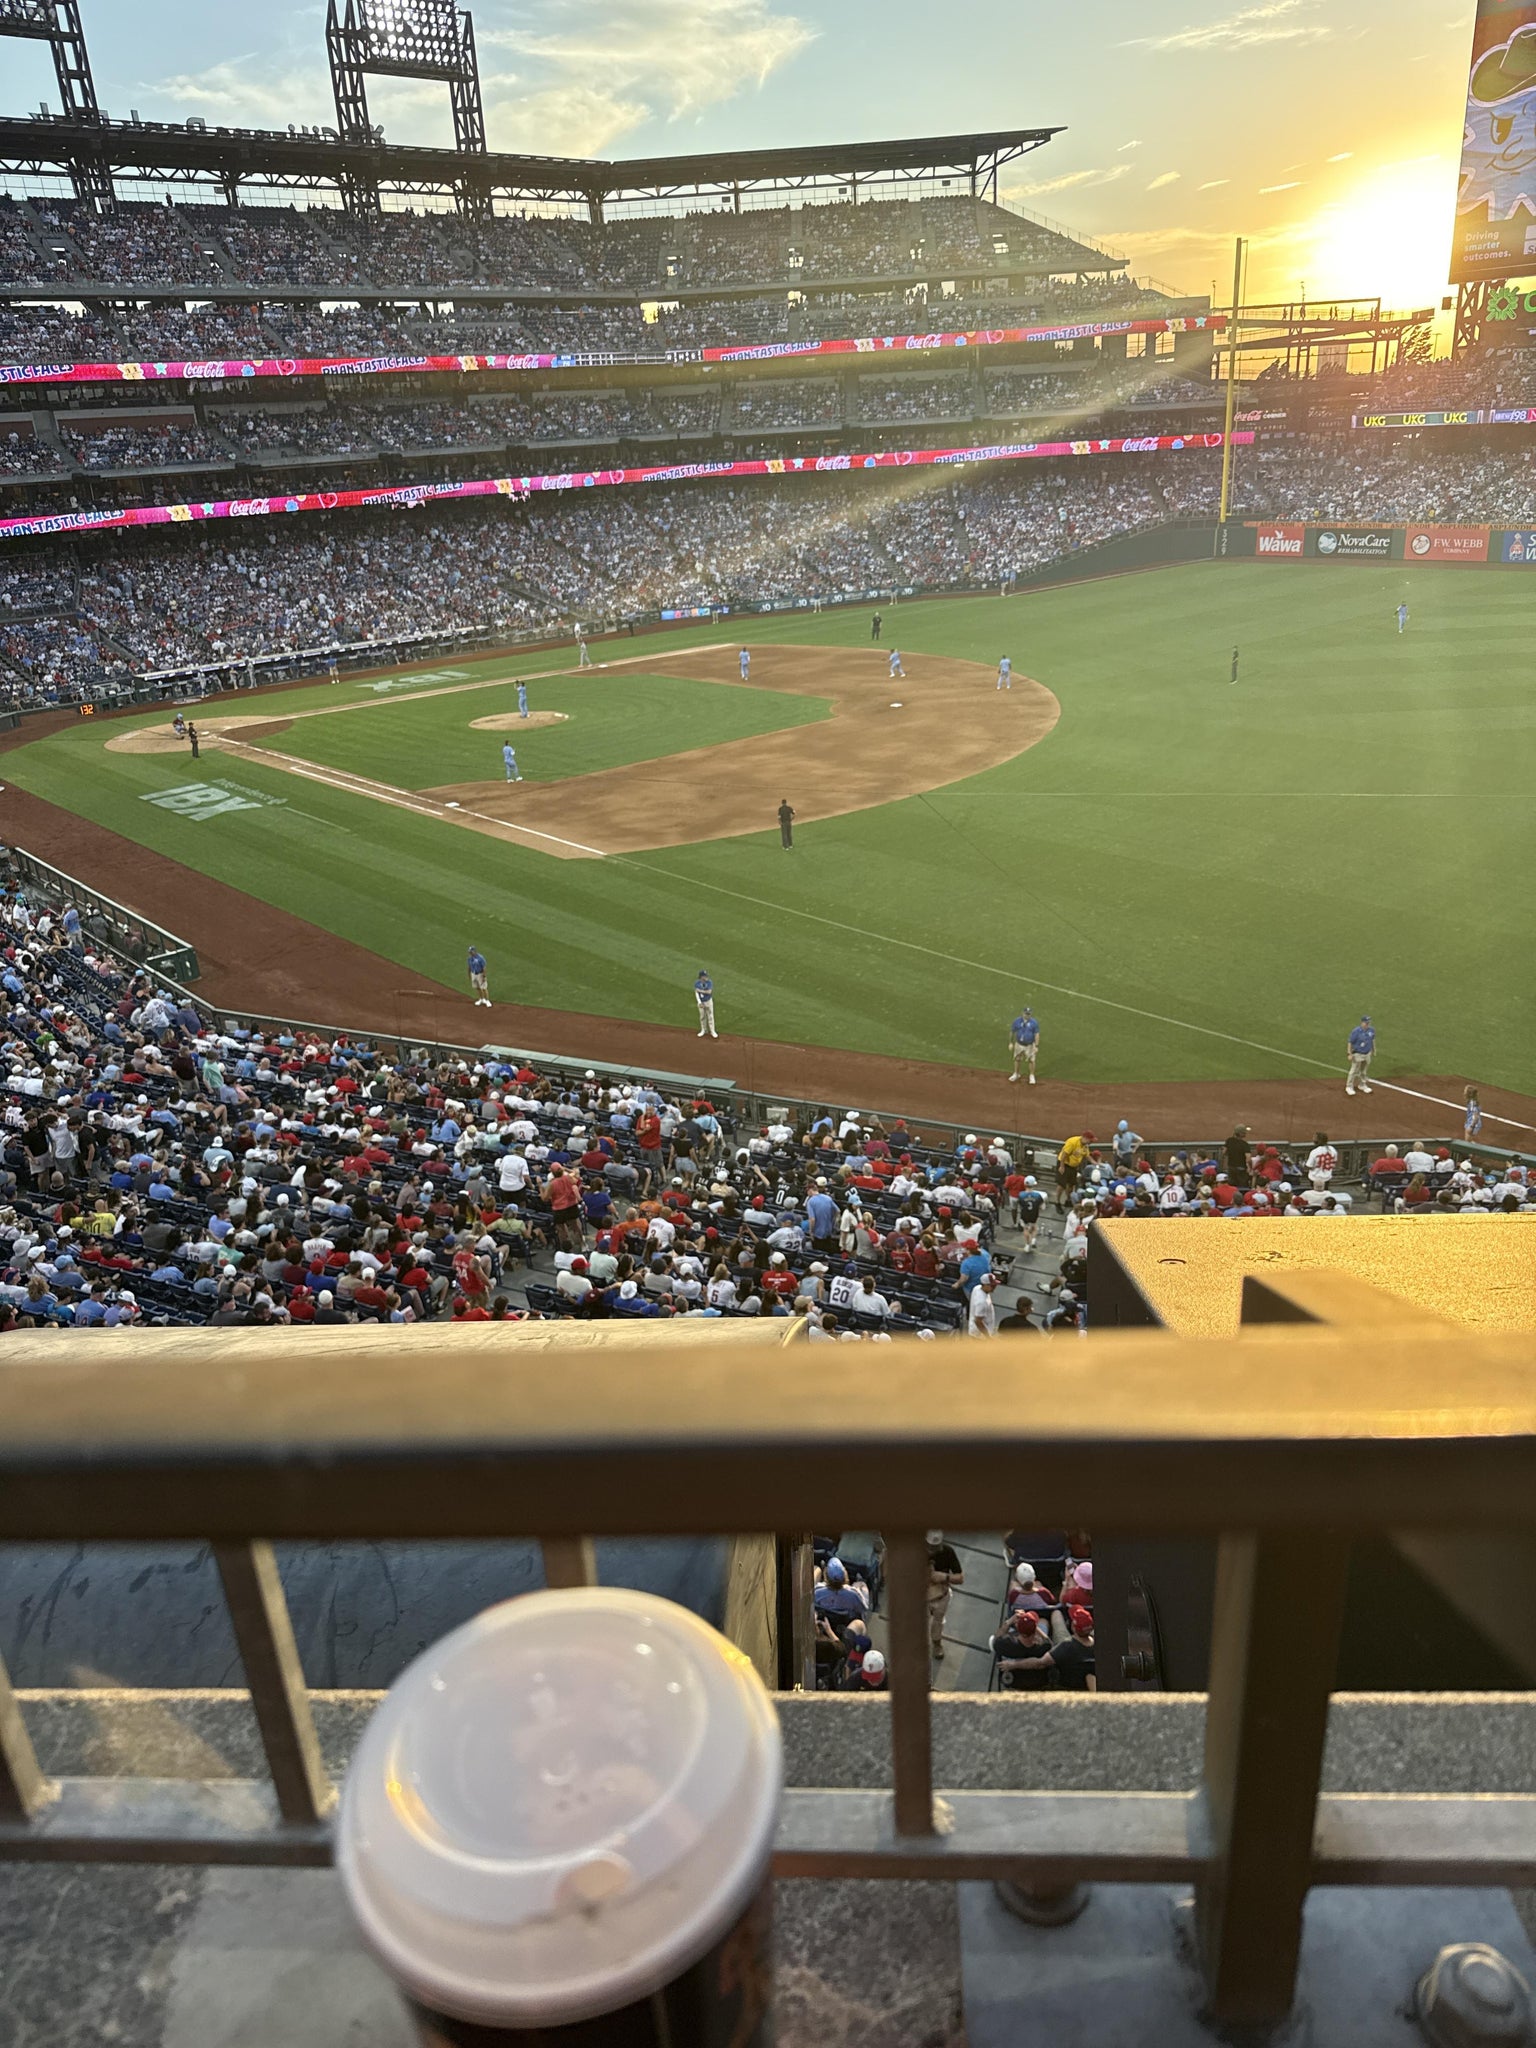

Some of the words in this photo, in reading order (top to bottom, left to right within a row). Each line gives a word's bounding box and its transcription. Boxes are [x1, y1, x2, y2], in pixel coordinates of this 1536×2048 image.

[1466, 230, 1499, 240] Driving
[1464, 242, 1500, 251] smarter
[1464, 250, 1511, 262] outcomes.
[1363, 416, 1386, 427] UKG
[1403, 414, 1426, 425] UKG
[1443, 412, 1468, 424] UKG
[0, 513, 84, 537] HAN-TASTIC
[1259, 536, 1303, 553] Wawa
[1338, 534, 1390, 547] NovaCare
[1453, 538, 1483, 548] WEBB
[138, 783, 263, 822] IBX
[1166, 1192, 1178, 1203] 10
[832, 1287, 850, 1303] 20
